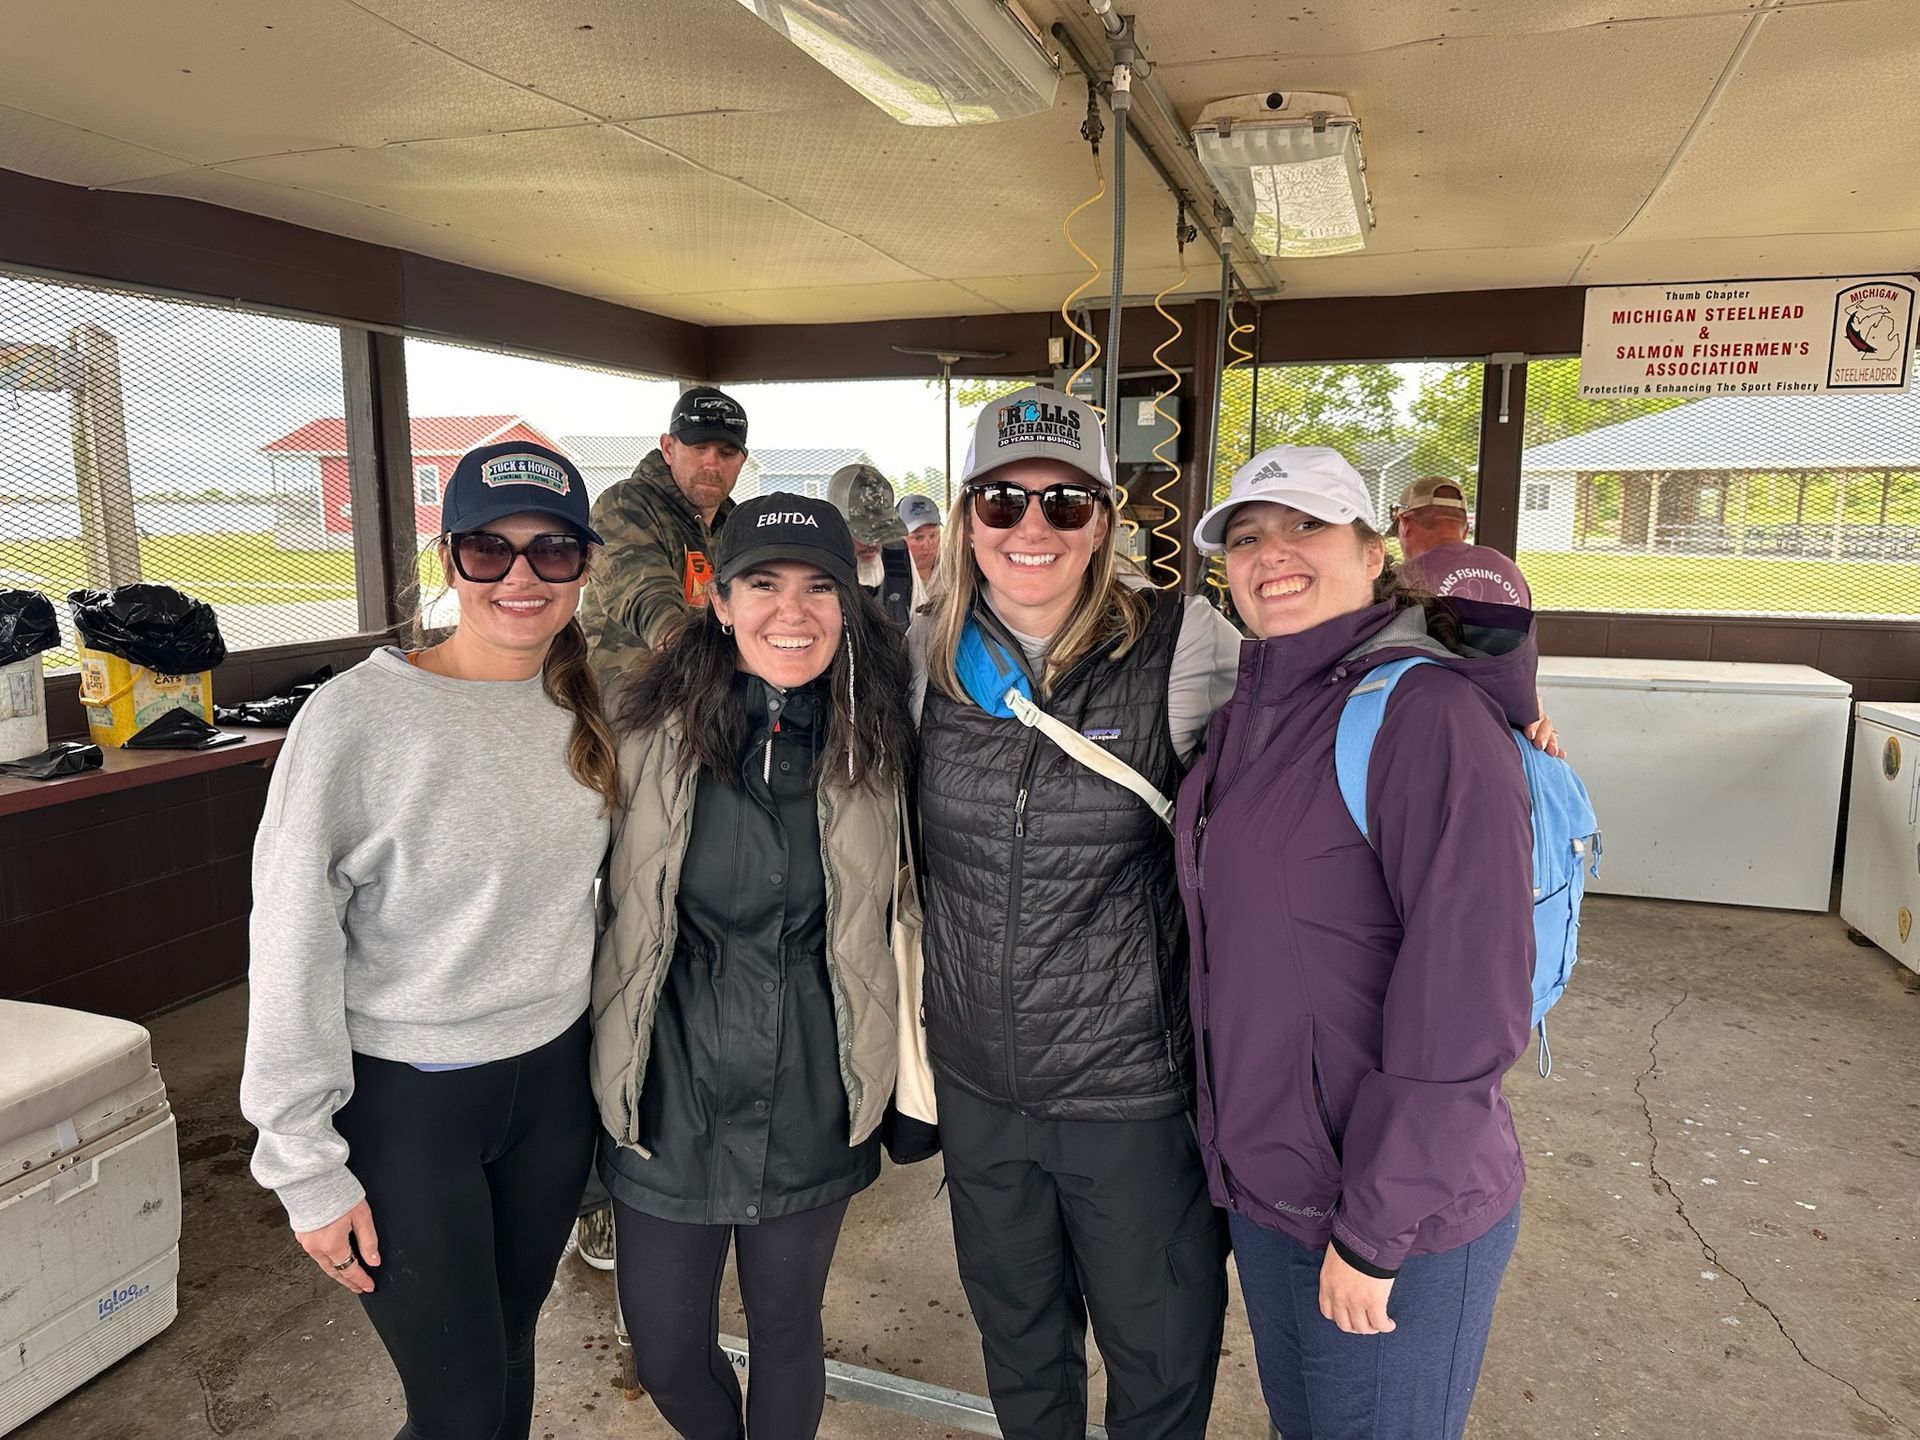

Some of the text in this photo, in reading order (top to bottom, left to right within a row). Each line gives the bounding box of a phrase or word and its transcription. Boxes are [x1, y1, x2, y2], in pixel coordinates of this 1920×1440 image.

[1665, 289, 1751, 301] Thumb Chapter
[1850, 288, 1899, 303] MICHIGAN
[1612, 305, 1805, 324] MICHIGAN STEELHEAD
[1698, 326, 1710, 340] &
[1616, 341, 1810, 360] SALMON FISHERMEN'S
[1645, 361, 1759, 376] ASSOCIATION
[1834, 367, 1897, 382] STEELHEADERS
[1583, 381, 1819, 394] Protecting & Enhancing The Sport Fishery
[998, 422, 1080, 443] MECHANICAL
[1010, 435, 1034, 443] YEARS
[1046, 435, 1080, 449] BUSINESS
[492, 461, 561, 480] TUCK & HOWELL
[1251, 471, 1288, 484] adidas
[756, 511, 819, 529] EBITDA
[1455, 568, 1502, 584] FISHING
[154, 675, 182, 685] CATS
[98, 1284, 138, 1315] igloo
